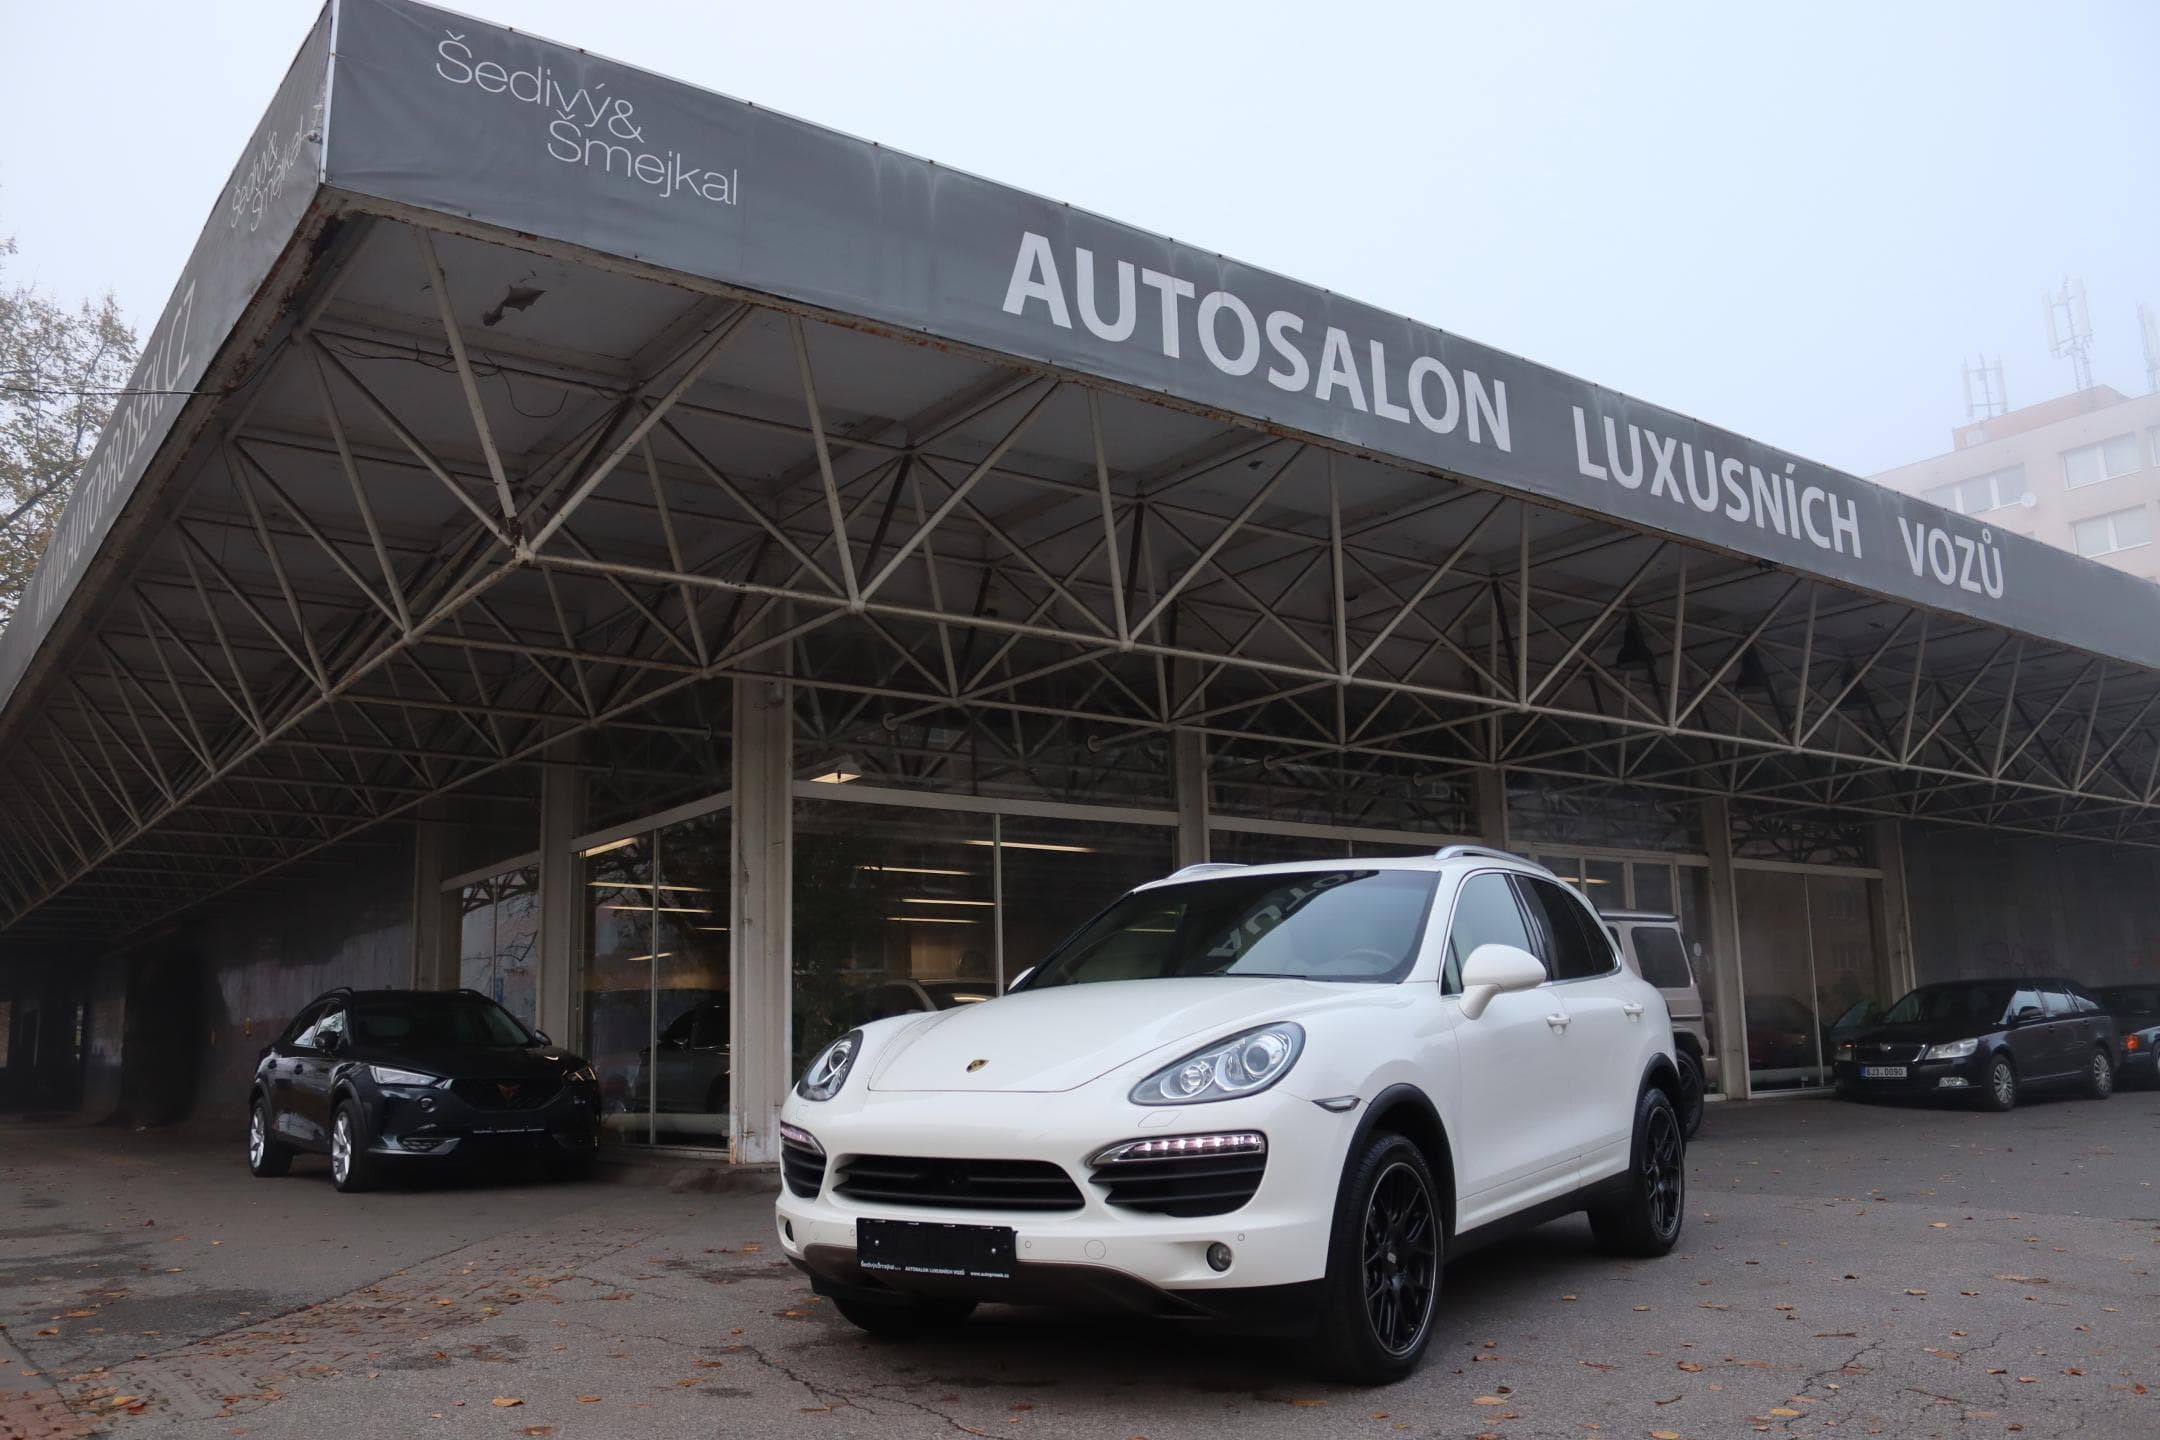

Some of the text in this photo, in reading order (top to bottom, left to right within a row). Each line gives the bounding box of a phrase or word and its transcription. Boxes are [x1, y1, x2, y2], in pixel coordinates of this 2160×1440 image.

[547, 109, 738, 206] Šmejkal
[1002, 231, 2005, 600] AUTOSALON LUXUSNÍCH VOZŮ
